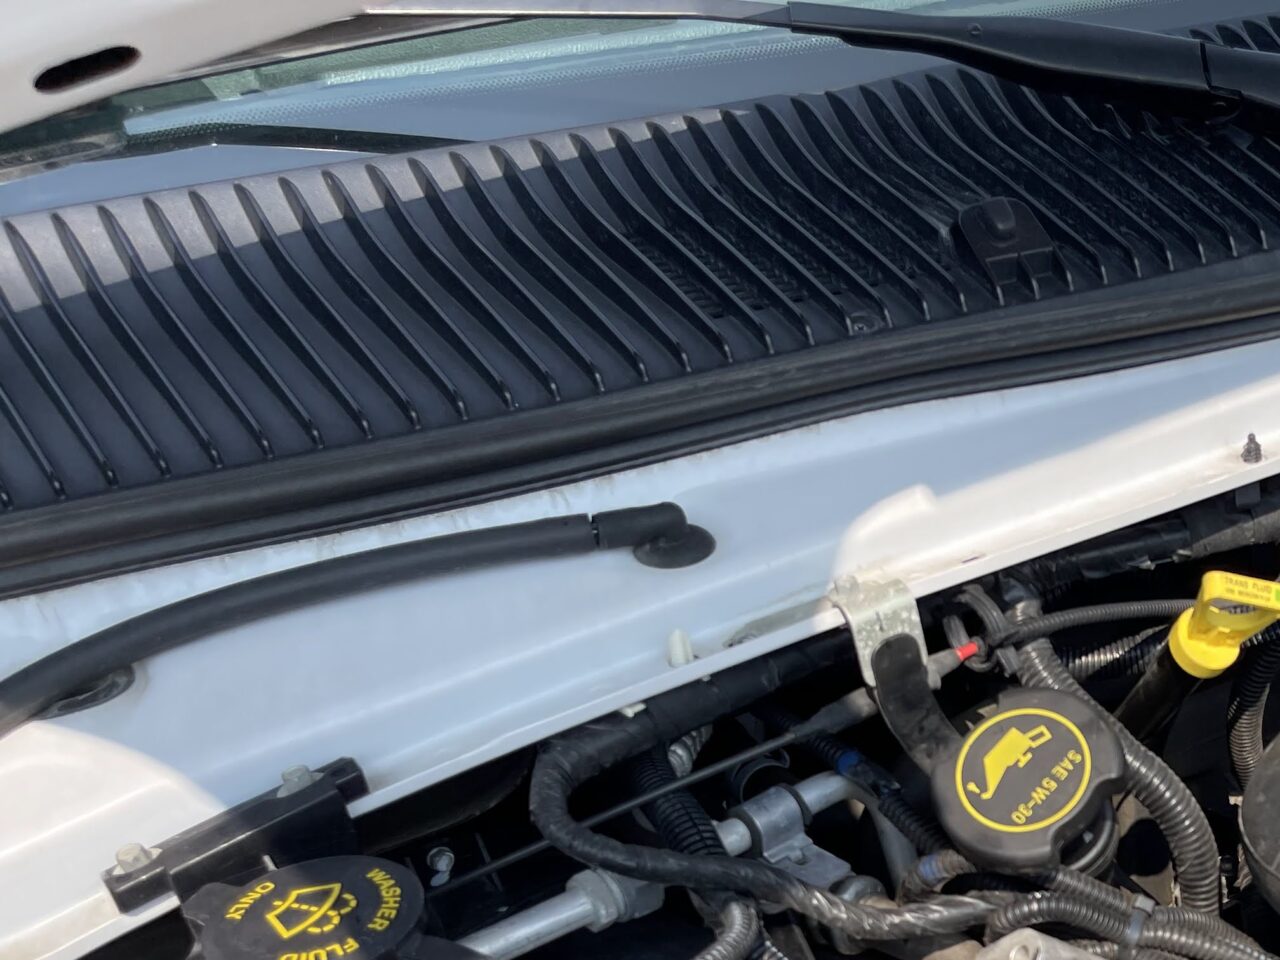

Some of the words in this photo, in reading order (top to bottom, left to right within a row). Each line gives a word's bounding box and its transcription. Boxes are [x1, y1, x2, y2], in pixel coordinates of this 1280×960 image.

[1223, 576, 1248, 589] TRANS
[1049, 746, 1086, 782] SAE
[1010, 774, 1063, 827] 5W-30
[224, 880, 276, 920] ONLY
[363, 867, 402, 932] WASHER
